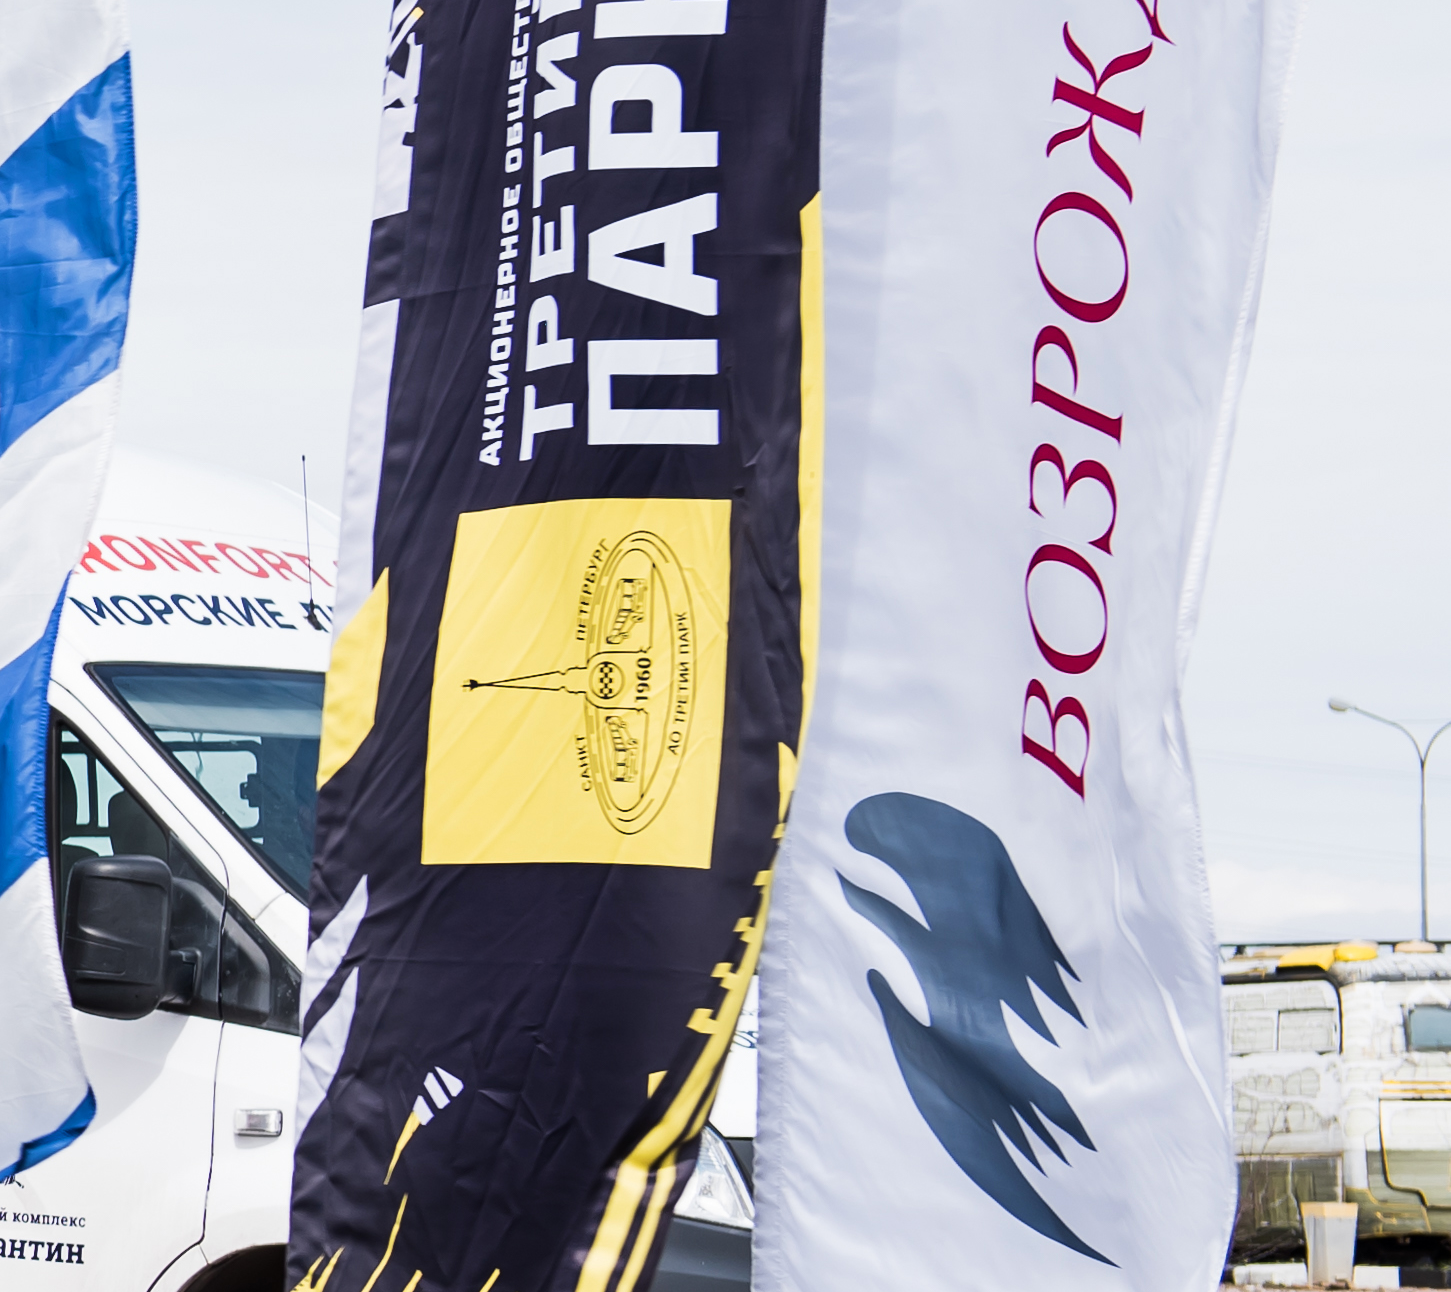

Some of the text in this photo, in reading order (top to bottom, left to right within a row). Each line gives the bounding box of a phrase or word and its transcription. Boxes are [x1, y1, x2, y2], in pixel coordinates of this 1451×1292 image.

[479, 184, 521, 466] АКЦИОНЕРНОЕ
[68, 594, 297, 630] МОРСКИЕ
[575, 537, 608, 792] САНКТ ПЕТЕРБУРГ
[634, 658, 652, 703] 1960
[667, 611, 690, 755] АО ТРЕТИЙ ПАРК
[13, 1212, 85, 1228] комплекс
